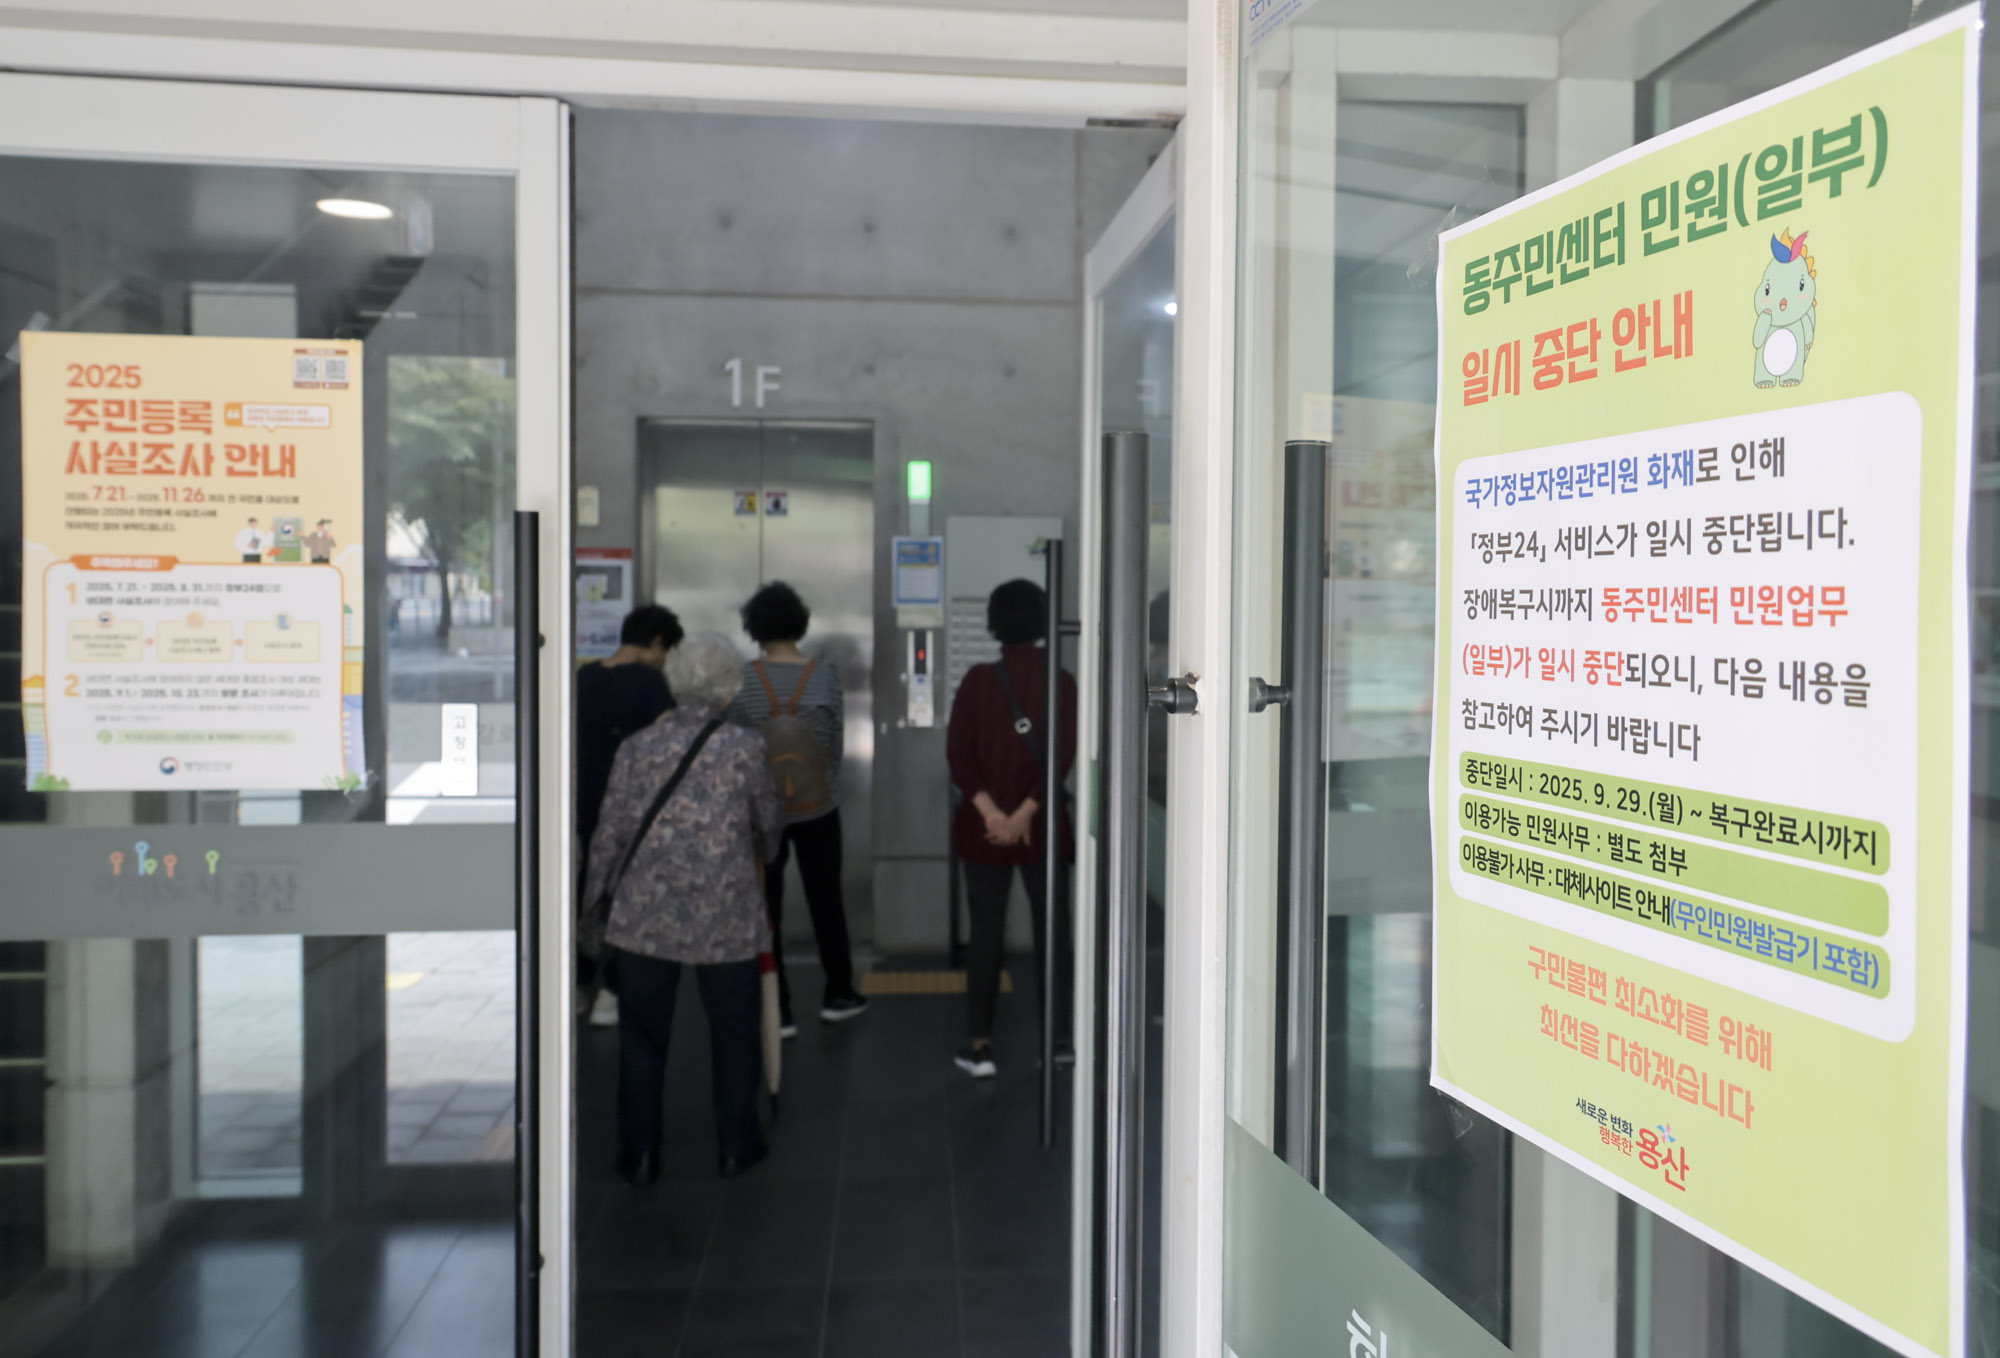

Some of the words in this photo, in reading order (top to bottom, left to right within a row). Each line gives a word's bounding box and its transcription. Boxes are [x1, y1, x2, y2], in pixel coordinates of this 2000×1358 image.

[1463, 201, 1626, 316] 동주민센터
[1640, 105, 1889, 258] 민원(일부)
[66, 364, 141, 389] 2025
[1461, 339, 1521, 407] 일시
[1532, 317, 1602, 391] 중단
[1612, 289, 1694, 374] 안내
[724, 358, 781, 407] 1F
[64, 398, 213, 435] 주민등록
[64, 440, 215, 477] 사실조사
[223, 443, 296, 479] 안내
[1464, 456, 1639, 509] 국가정보자원관리원
[1646, 448, 1721, 490] 화재로
[1731, 437, 1786, 482] 인해
[1470, 530, 1546, 564] 「정부24」
[1554, 521, 1638, 561] 서비스가
[1646, 518, 1692, 557] 일시
[1702, 506, 1855, 556] 중단됩니다.
[1463, 587, 1593, 622] 장애복구시까지
[1601, 586, 1719, 624] 동주민센터
[1730, 585, 1848, 627] 민원업무
[1462, 642, 1531, 679] (일부)가
[1537, 646, 1575, 682] 일시
[1583, 650, 1703, 696] 중단되오니,
[1713, 656, 1767, 700] 다음
[1778, 660, 1871, 708] 내용을
[1461, 698, 1533, 737] 참고하여
[1540, 708, 1599, 747] 주시기
[1607, 715, 1701, 762] 바랍니다
[1464, 801, 1522, 837] 이용가능
[1526, 814, 1590, 852] 민원사무
[1607, 831, 1643, 865] 별도
[1648, 842, 1688, 877] 첨부
[1465, 758, 1523, 793] 중단일시
[1539, 773, 1588, 804] 2025.
[1593, 784, 1610, 809] 9.
[1709, 802, 1878, 866] 복구완료시까지
[1555, 867, 1632, 912] 대체사이트
[1823, 941, 1879, 989] 포함)
[1528, 945, 1608, 1005] 구민불편
[1614, 975, 1711, 1047] 최소화를
[1718, 1014, 1773, 1072] 위해
[1540, 1003, 1601, 1061] 최선을
[1606, 1031, 1755, 1129] 다하겠습니다
[1575, 1096, 1608, 1126] 새로운
[1609, 1113, 1634, 1138] 변화
[1598, 1125, 1634, 1157] 행복한
[1635, 1126, 1691, 1192] 용산
